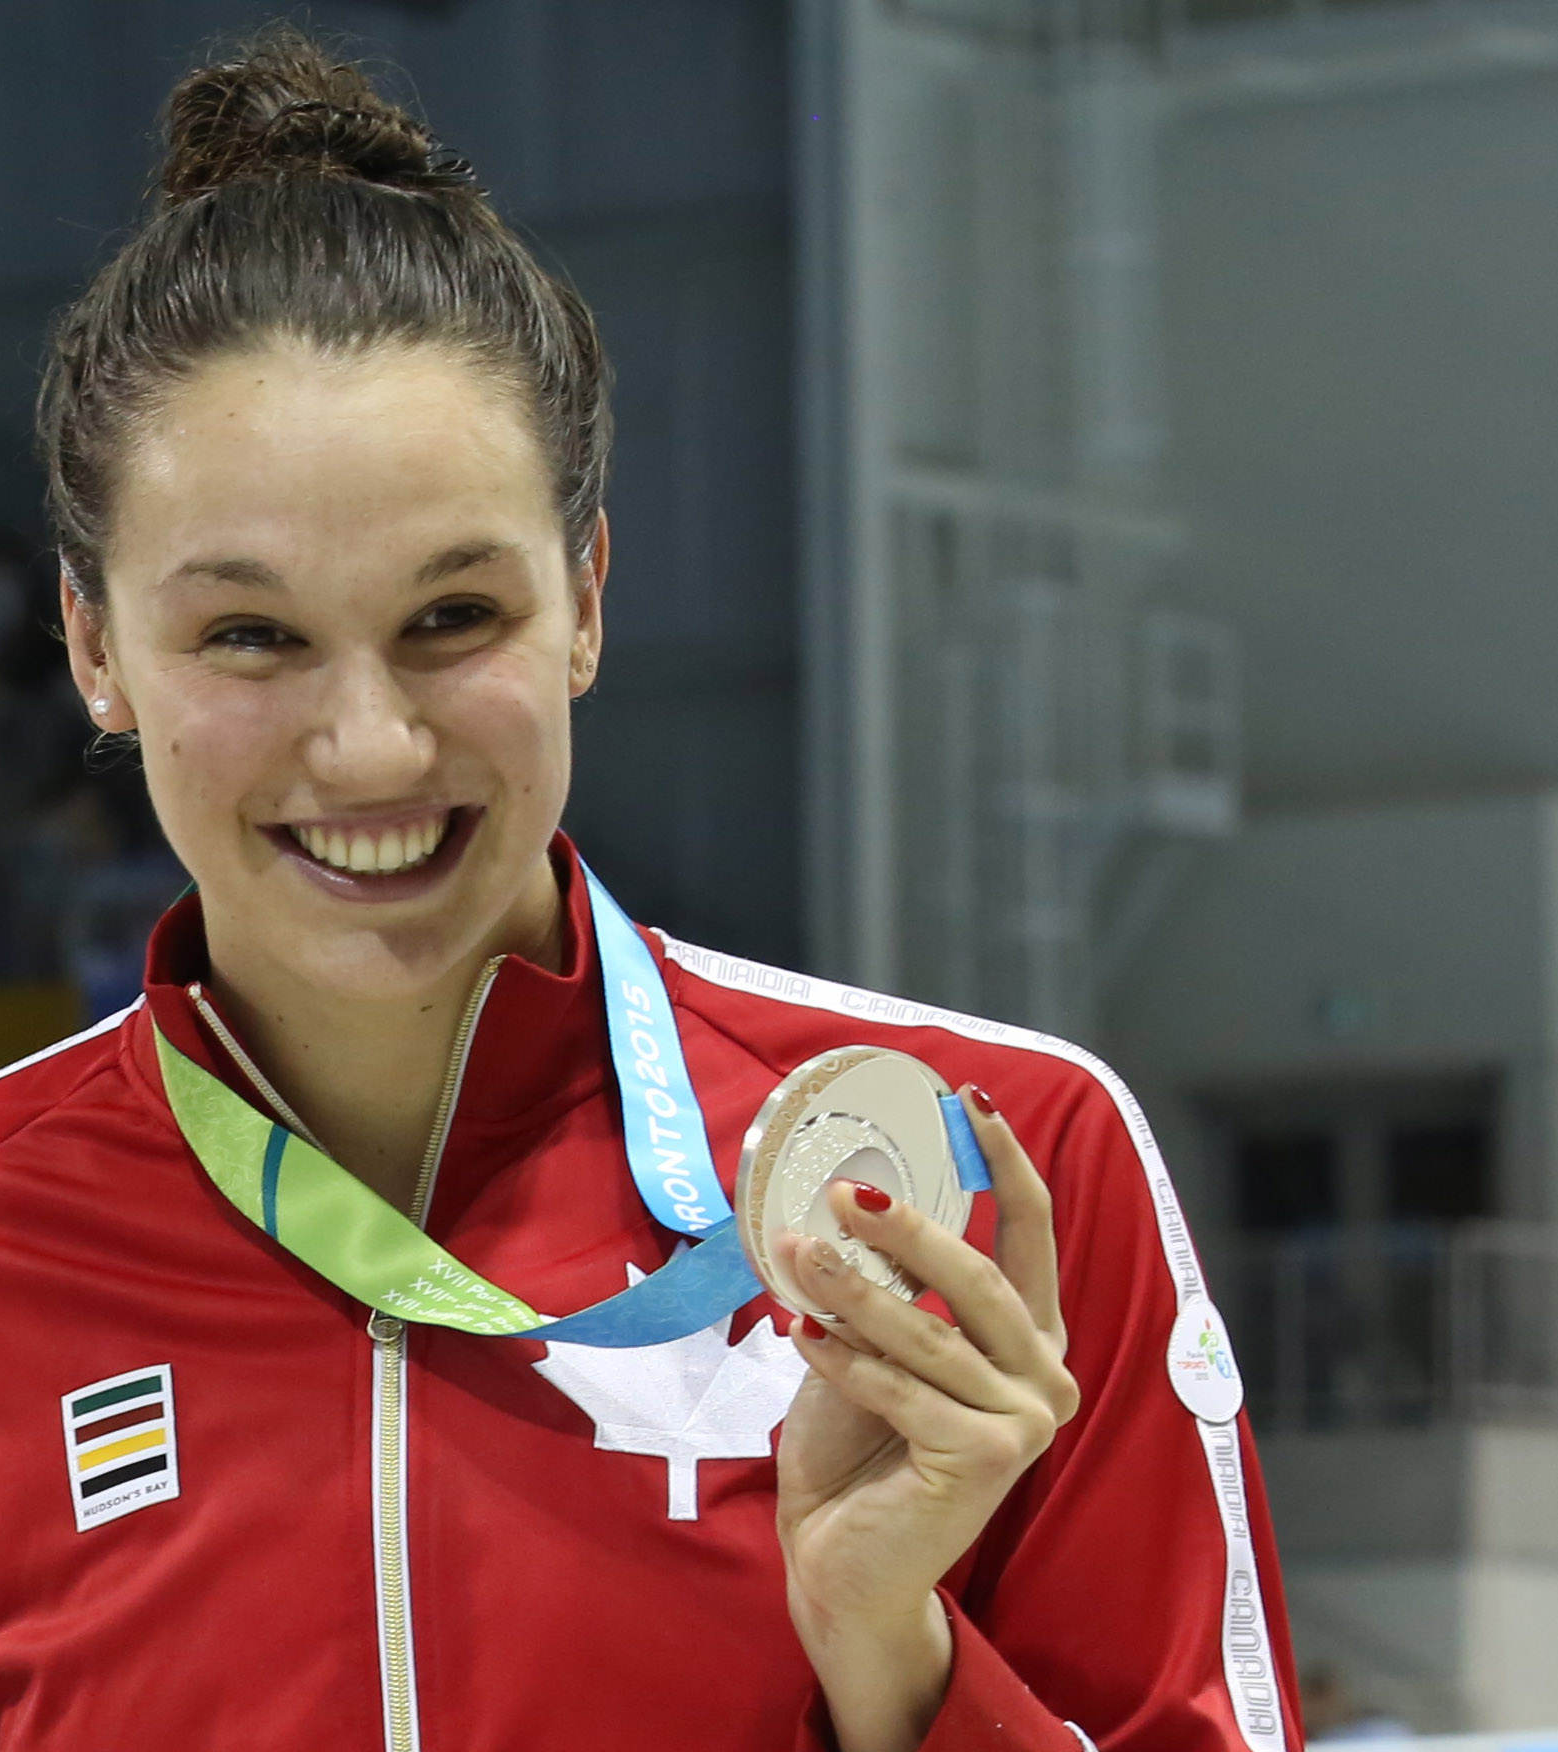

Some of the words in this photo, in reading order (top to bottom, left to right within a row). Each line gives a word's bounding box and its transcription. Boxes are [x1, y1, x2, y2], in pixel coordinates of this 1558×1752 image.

[381, 1289, 422, 1311] XVII
[428, 1258, 470, 1288] XVII
[466, 1284, 500, 1302] Pan
[83, 1489, 142, 1518] HUDSON'S
[145, 1481, 169, 1494] BAY
[1229, 1568, 1278, 1738] CANADA
